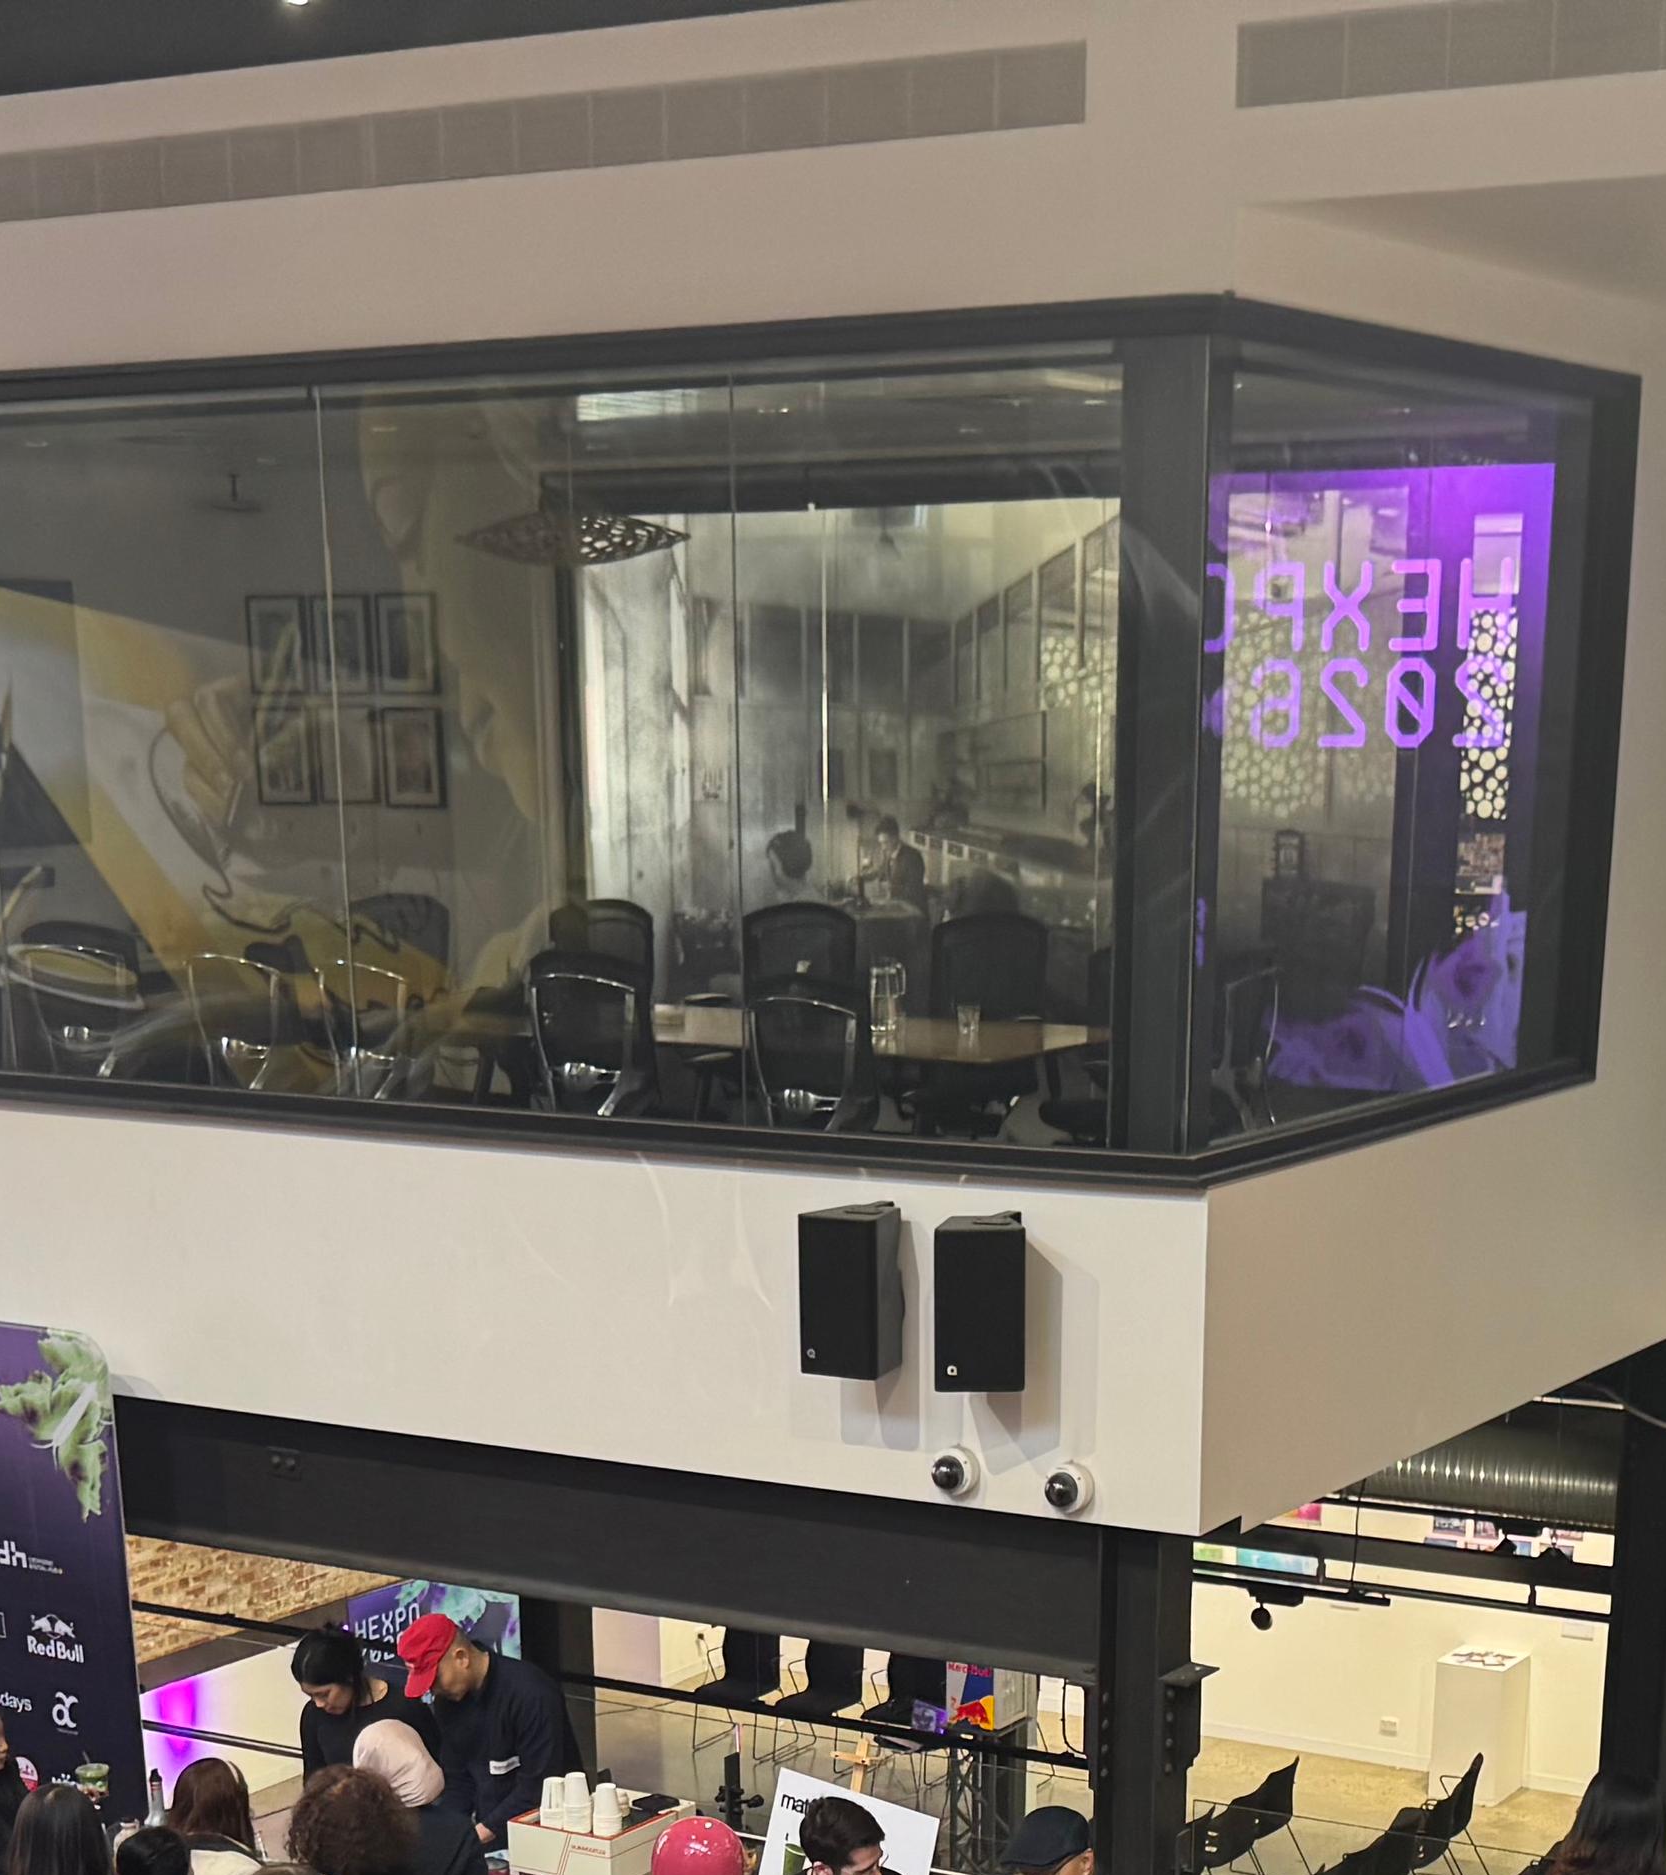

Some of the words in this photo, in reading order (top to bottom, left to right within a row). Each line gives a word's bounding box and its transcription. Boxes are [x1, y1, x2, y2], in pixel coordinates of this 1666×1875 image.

[355, 1603, 421, 1640] HEXPO
[27, 1635, 57, 1659] Red
[57, 1640, 84, 1663] Bull
[781, 1793, 808, 1815] mat
